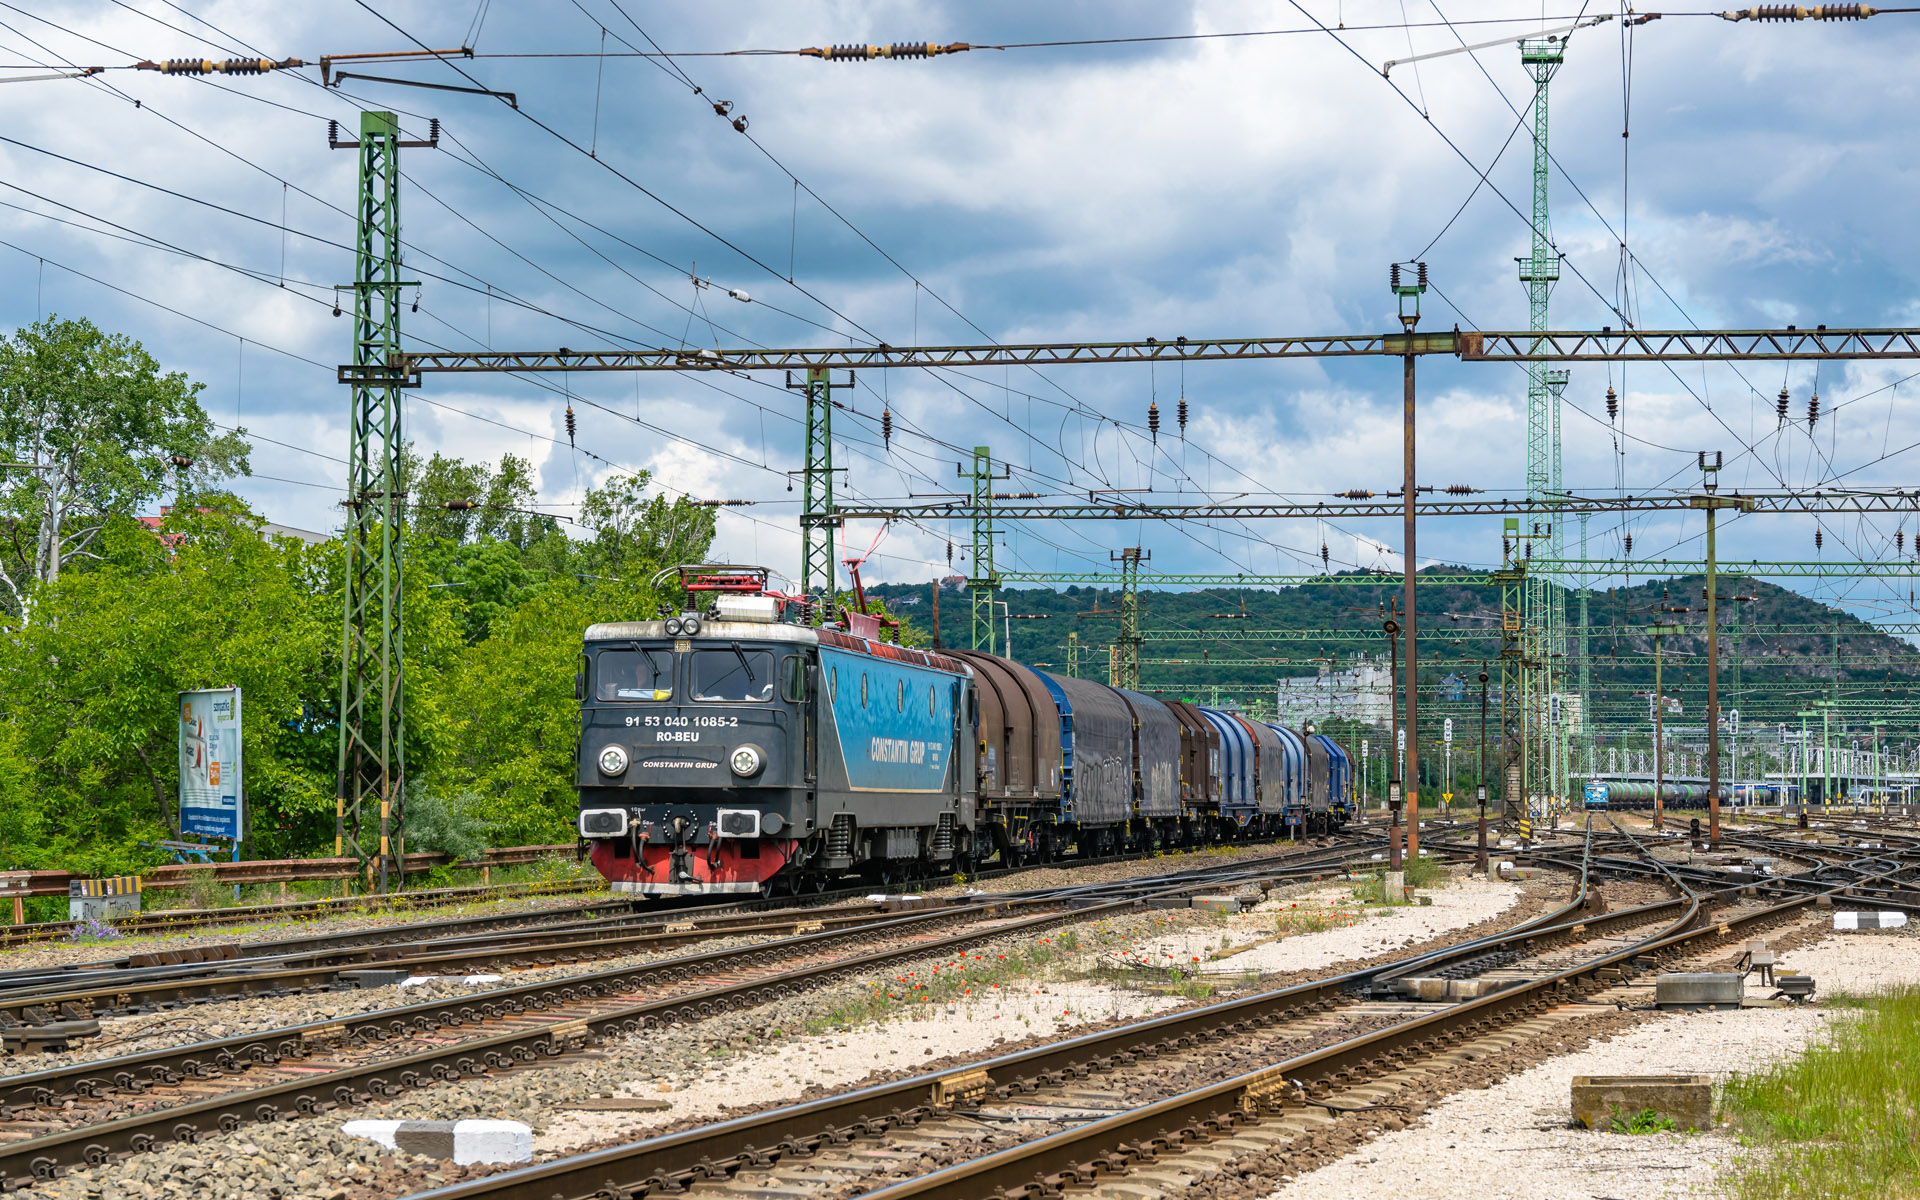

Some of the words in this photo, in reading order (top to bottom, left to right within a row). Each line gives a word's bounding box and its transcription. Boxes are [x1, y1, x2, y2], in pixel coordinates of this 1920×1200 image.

[625, 716, 640, 727] 91
[644, 716, 660, 727] 53
[664, 716, 689, 727] 040
[692, 716, 739, 727] 1085-2
[656, 731, 700, 742] RO-BEU
[871, 736, 909, 764] CONSTANTIN
[910, 740, 925, 765] GRUP
[642, 761, 694, 769] CONSTANTIN
